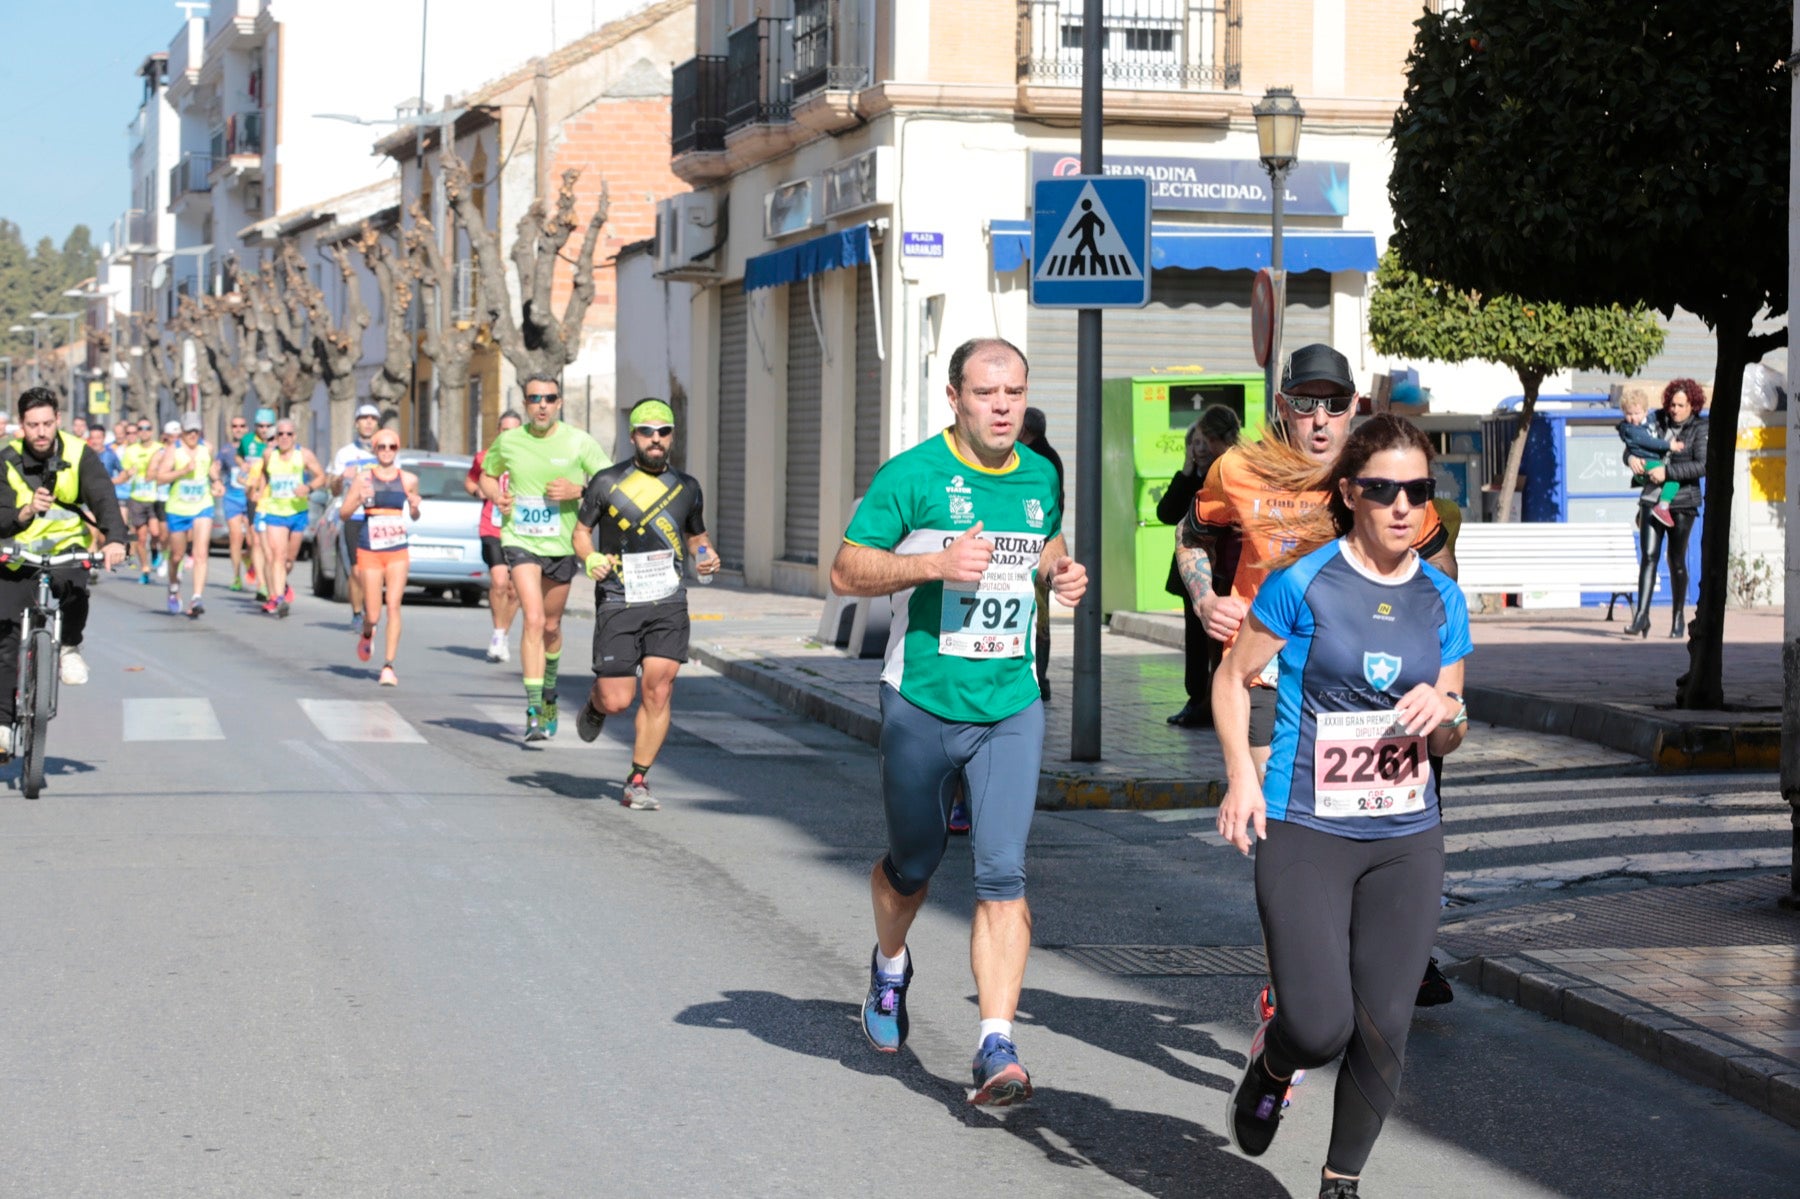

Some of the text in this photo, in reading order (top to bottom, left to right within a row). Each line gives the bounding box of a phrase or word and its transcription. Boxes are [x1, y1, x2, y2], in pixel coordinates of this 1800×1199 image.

[911, 232, 934, 242] PLAZA
[905, 243, 942, 256] NARANJOS
[522, 508, 552, 523] 209
[960, 597, 1021, 630] 792
[1345, 715, 1365, 726] GRAN
[1366, 713, 1391, 725] PREMIO
[1323, 742, 1419, 783] 2261
